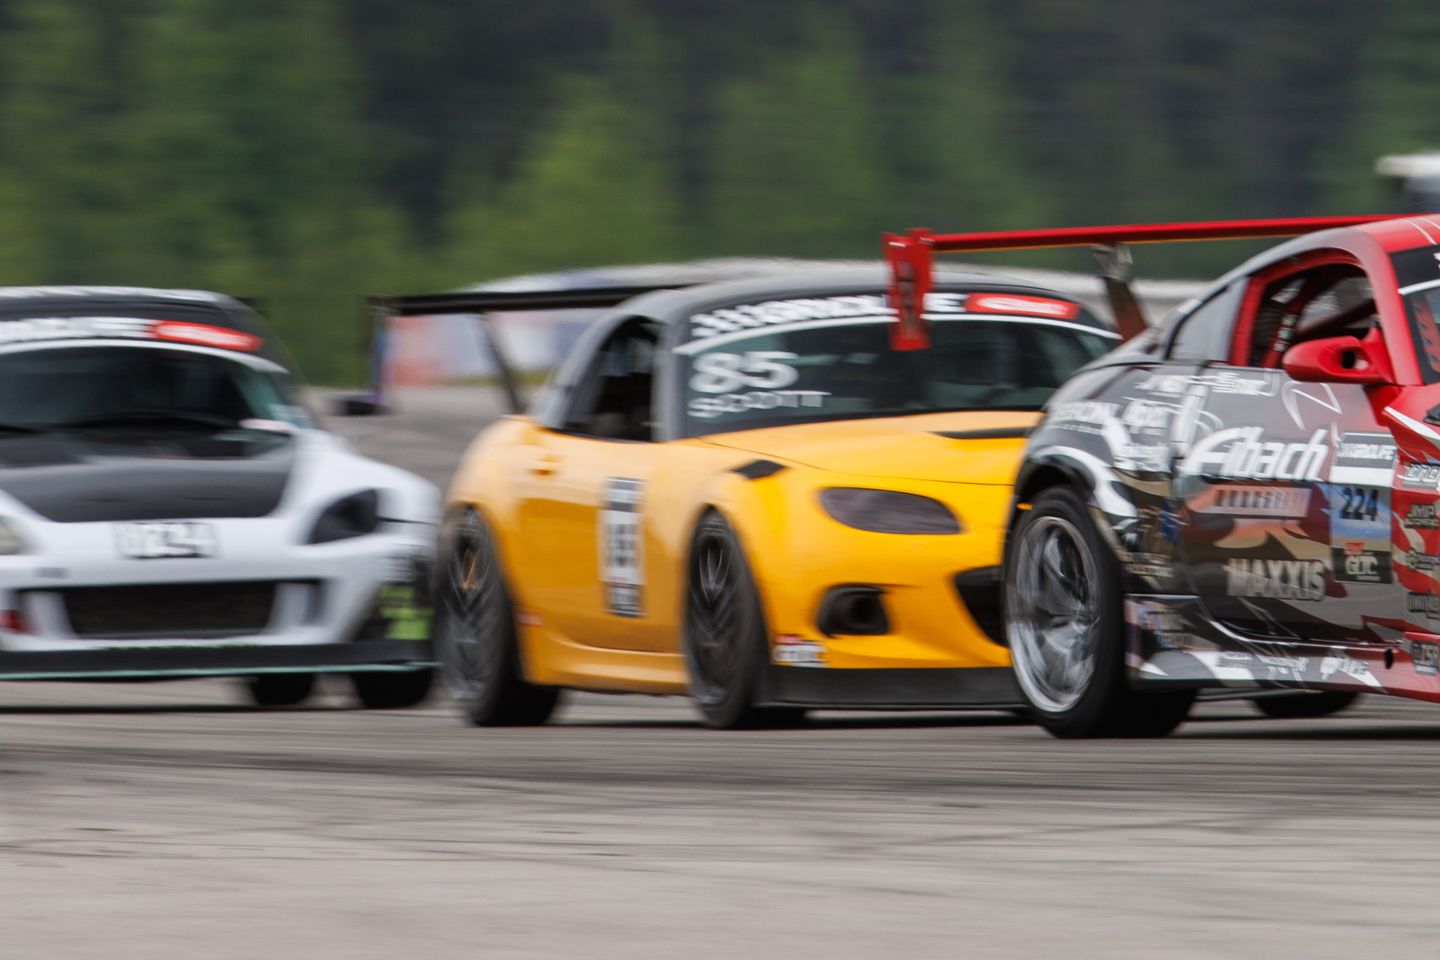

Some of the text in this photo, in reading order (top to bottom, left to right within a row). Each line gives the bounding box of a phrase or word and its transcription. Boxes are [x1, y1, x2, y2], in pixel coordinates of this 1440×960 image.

[689, 351, 799, 394] 85
[687, 390, 830, 418] SCOTT
[1340, 486, 1379, 521] 224
[1226, 558, 1325, 602] MAXXIS
